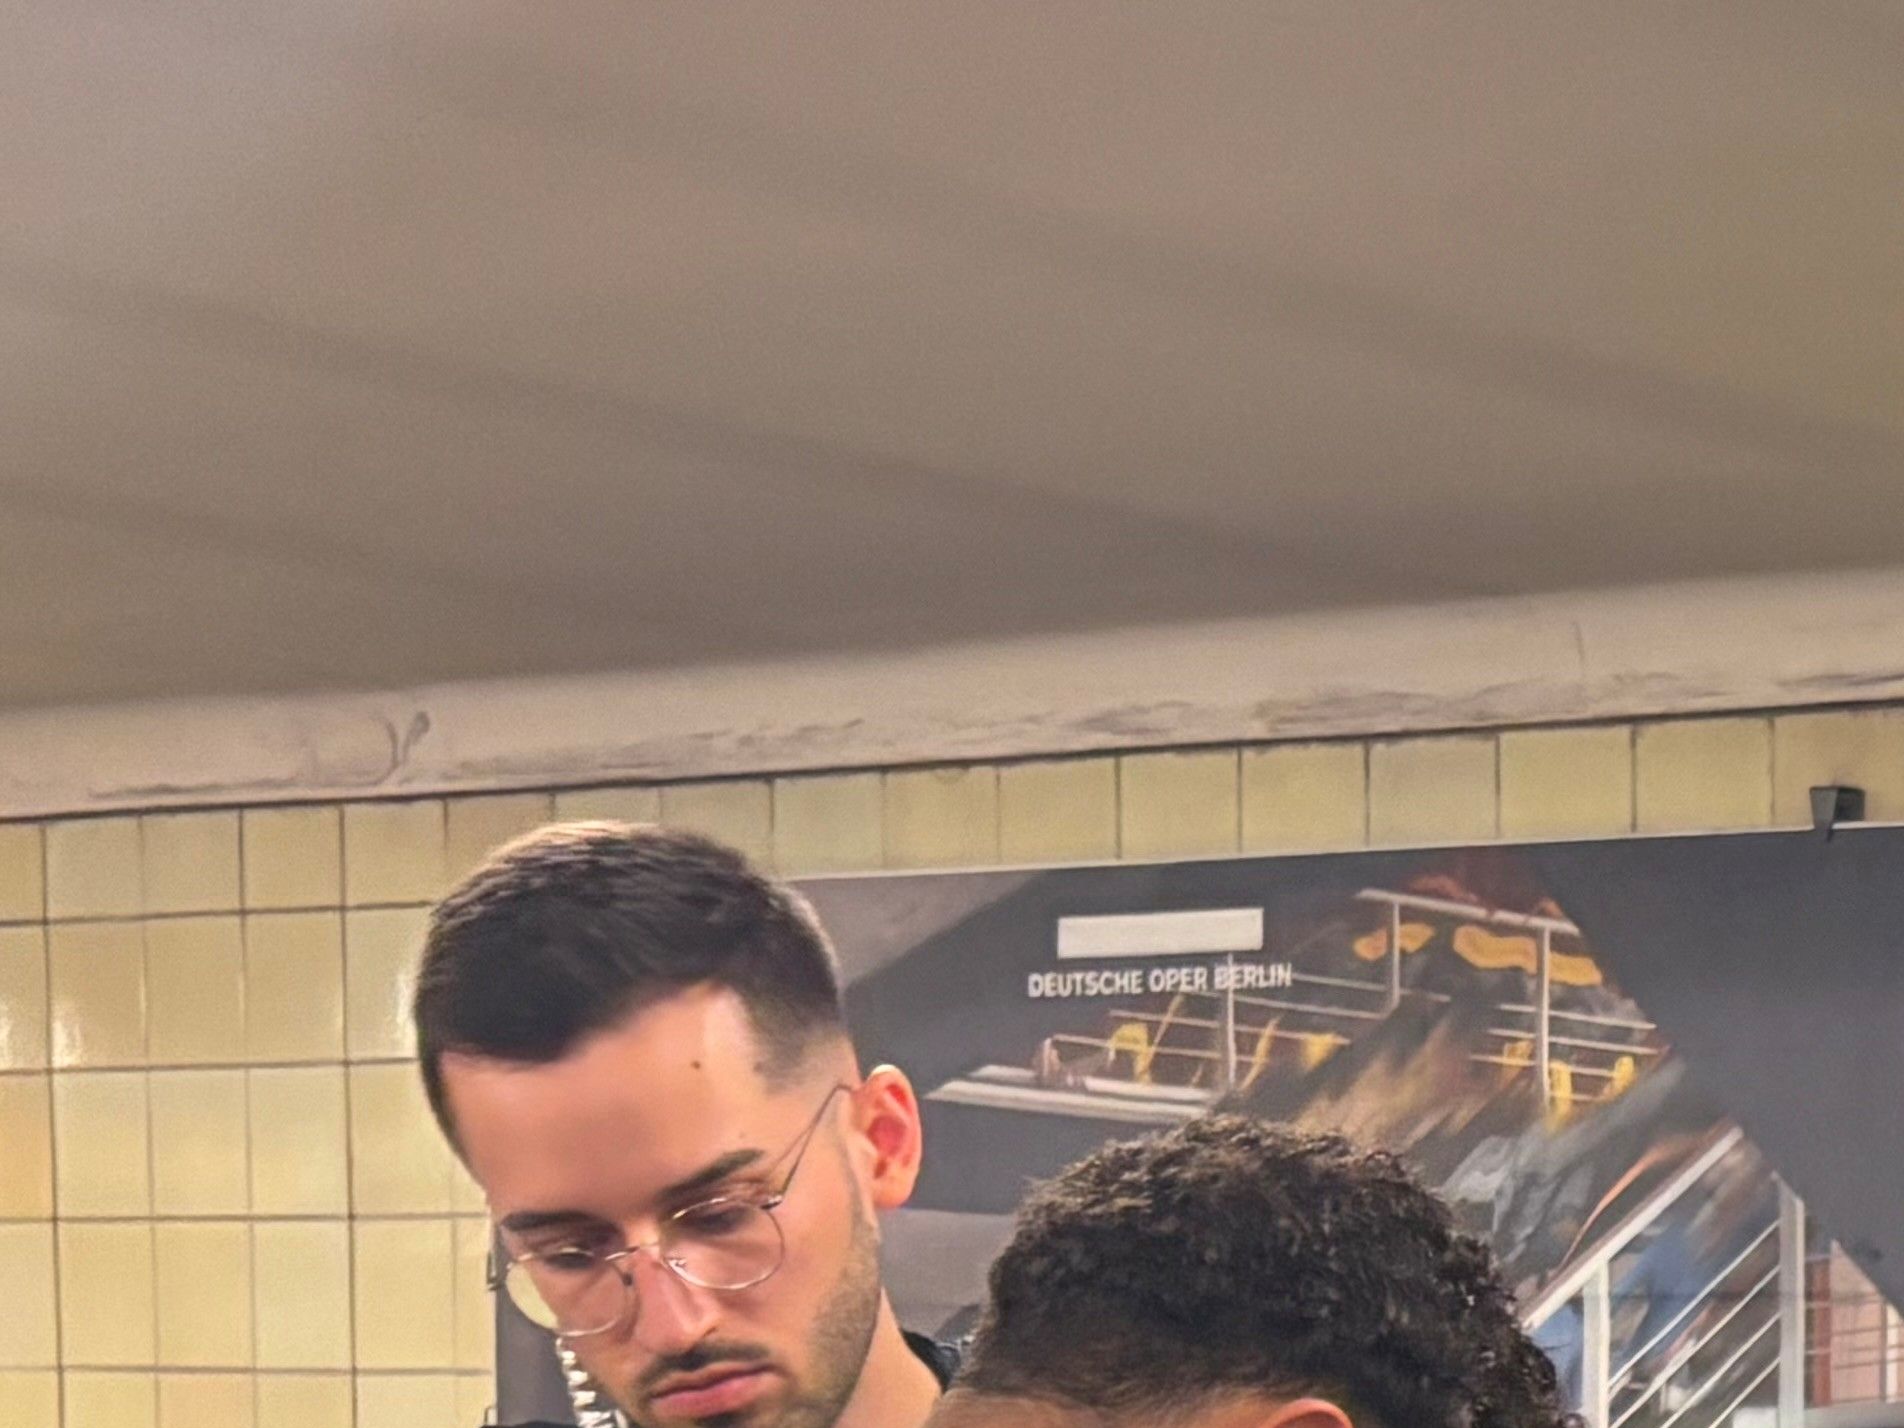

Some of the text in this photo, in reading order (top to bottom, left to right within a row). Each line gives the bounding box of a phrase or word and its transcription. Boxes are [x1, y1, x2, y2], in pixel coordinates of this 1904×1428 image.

[1027, 961, 1293, 998] DEUTSCHE OPER BERLIN
